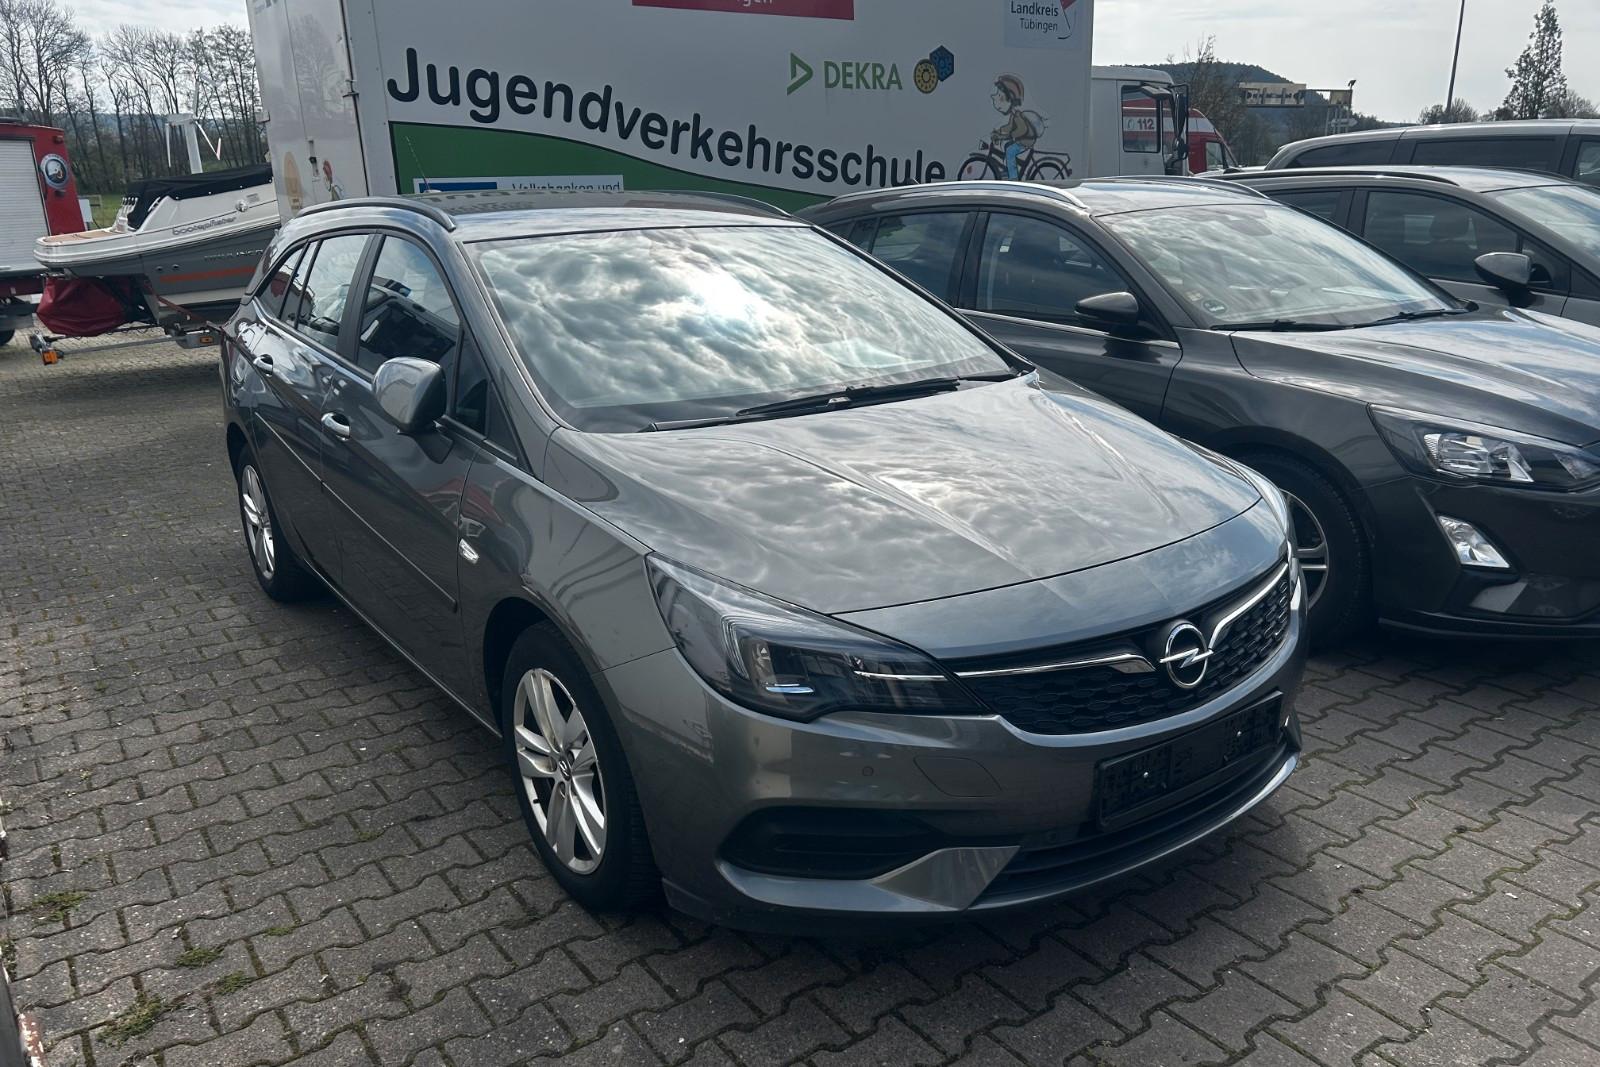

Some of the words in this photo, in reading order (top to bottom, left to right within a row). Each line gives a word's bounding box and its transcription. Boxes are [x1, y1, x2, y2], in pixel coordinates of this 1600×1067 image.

[1010, 0, 1059, 17] Landkreis
[1019, 18, 1058, 33] Tübingen
[824, 61, 903, 90] DEKRA
[387, 47, 946, 188] Jugendverkehrsschule
[1136, 118, 1155, 130] 112
